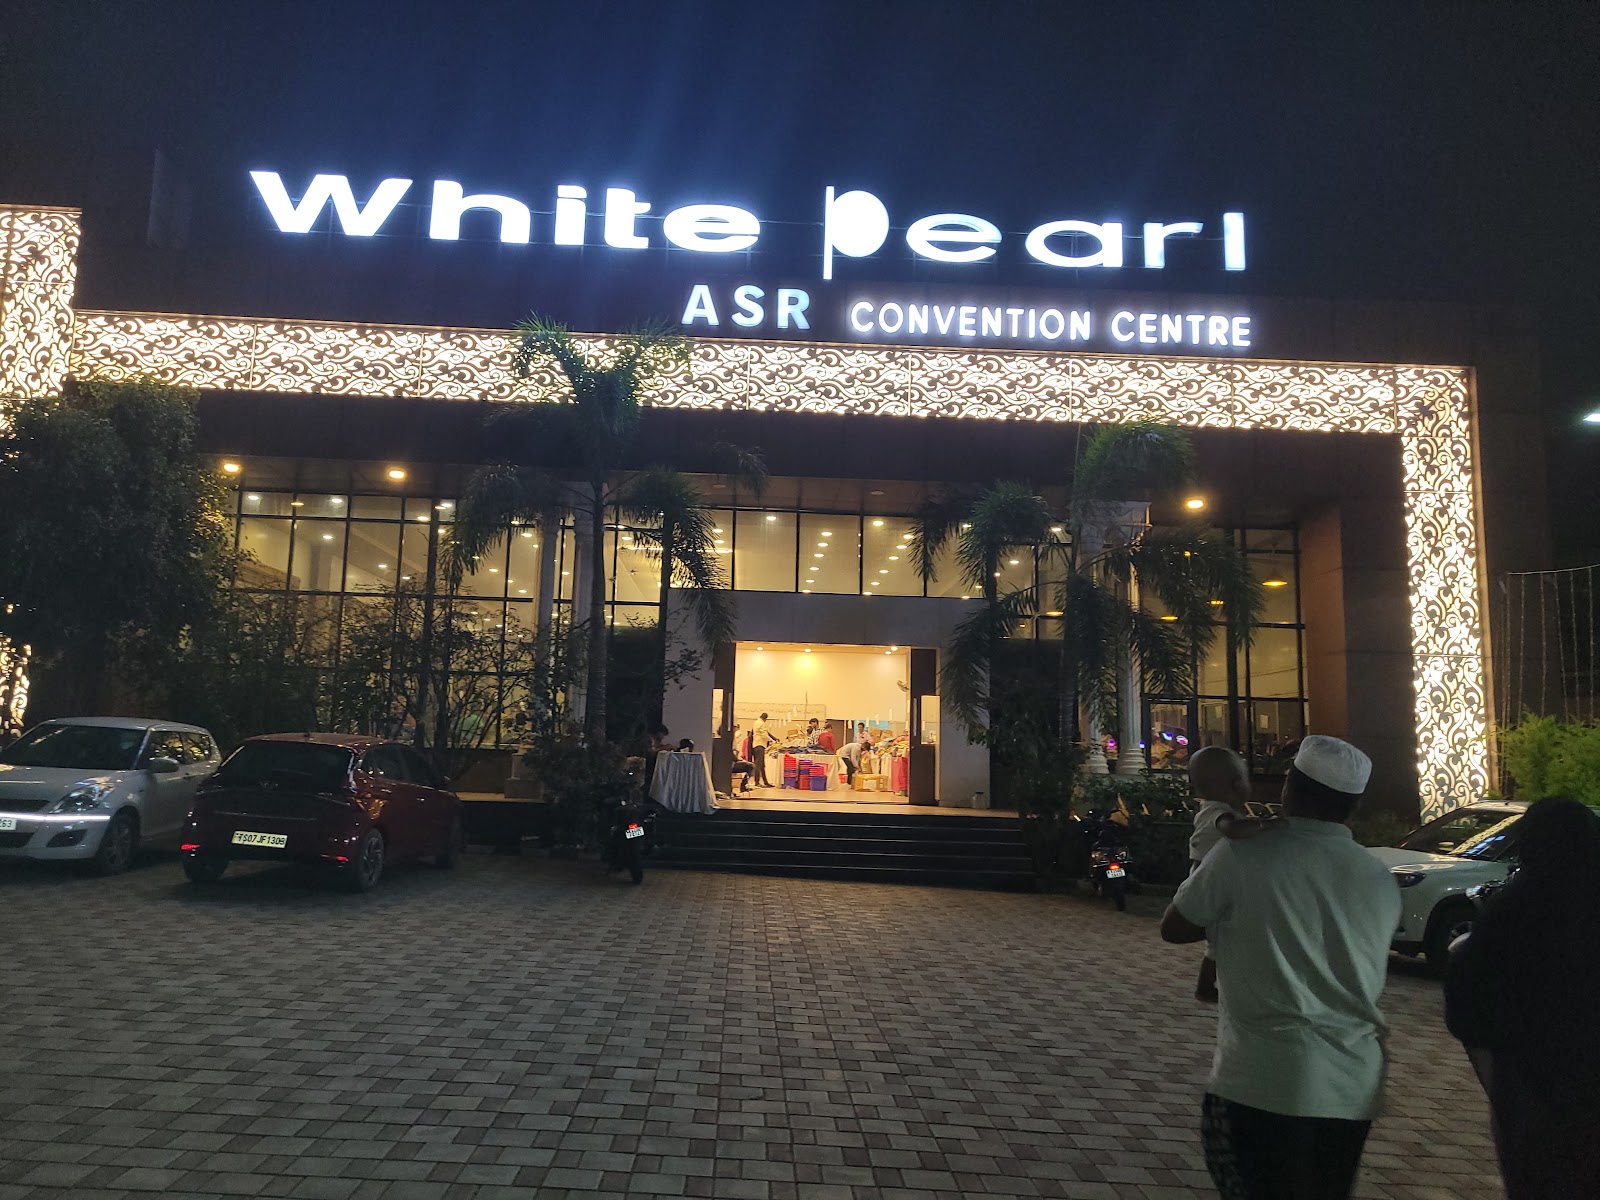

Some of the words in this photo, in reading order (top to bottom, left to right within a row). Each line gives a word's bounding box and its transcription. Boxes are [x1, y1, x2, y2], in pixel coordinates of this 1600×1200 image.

[681, 284, 810, 329] ASR
[850, 300, 1091, 342] CONVENTION
[1110, 310, 1252, 348] CENTRE
